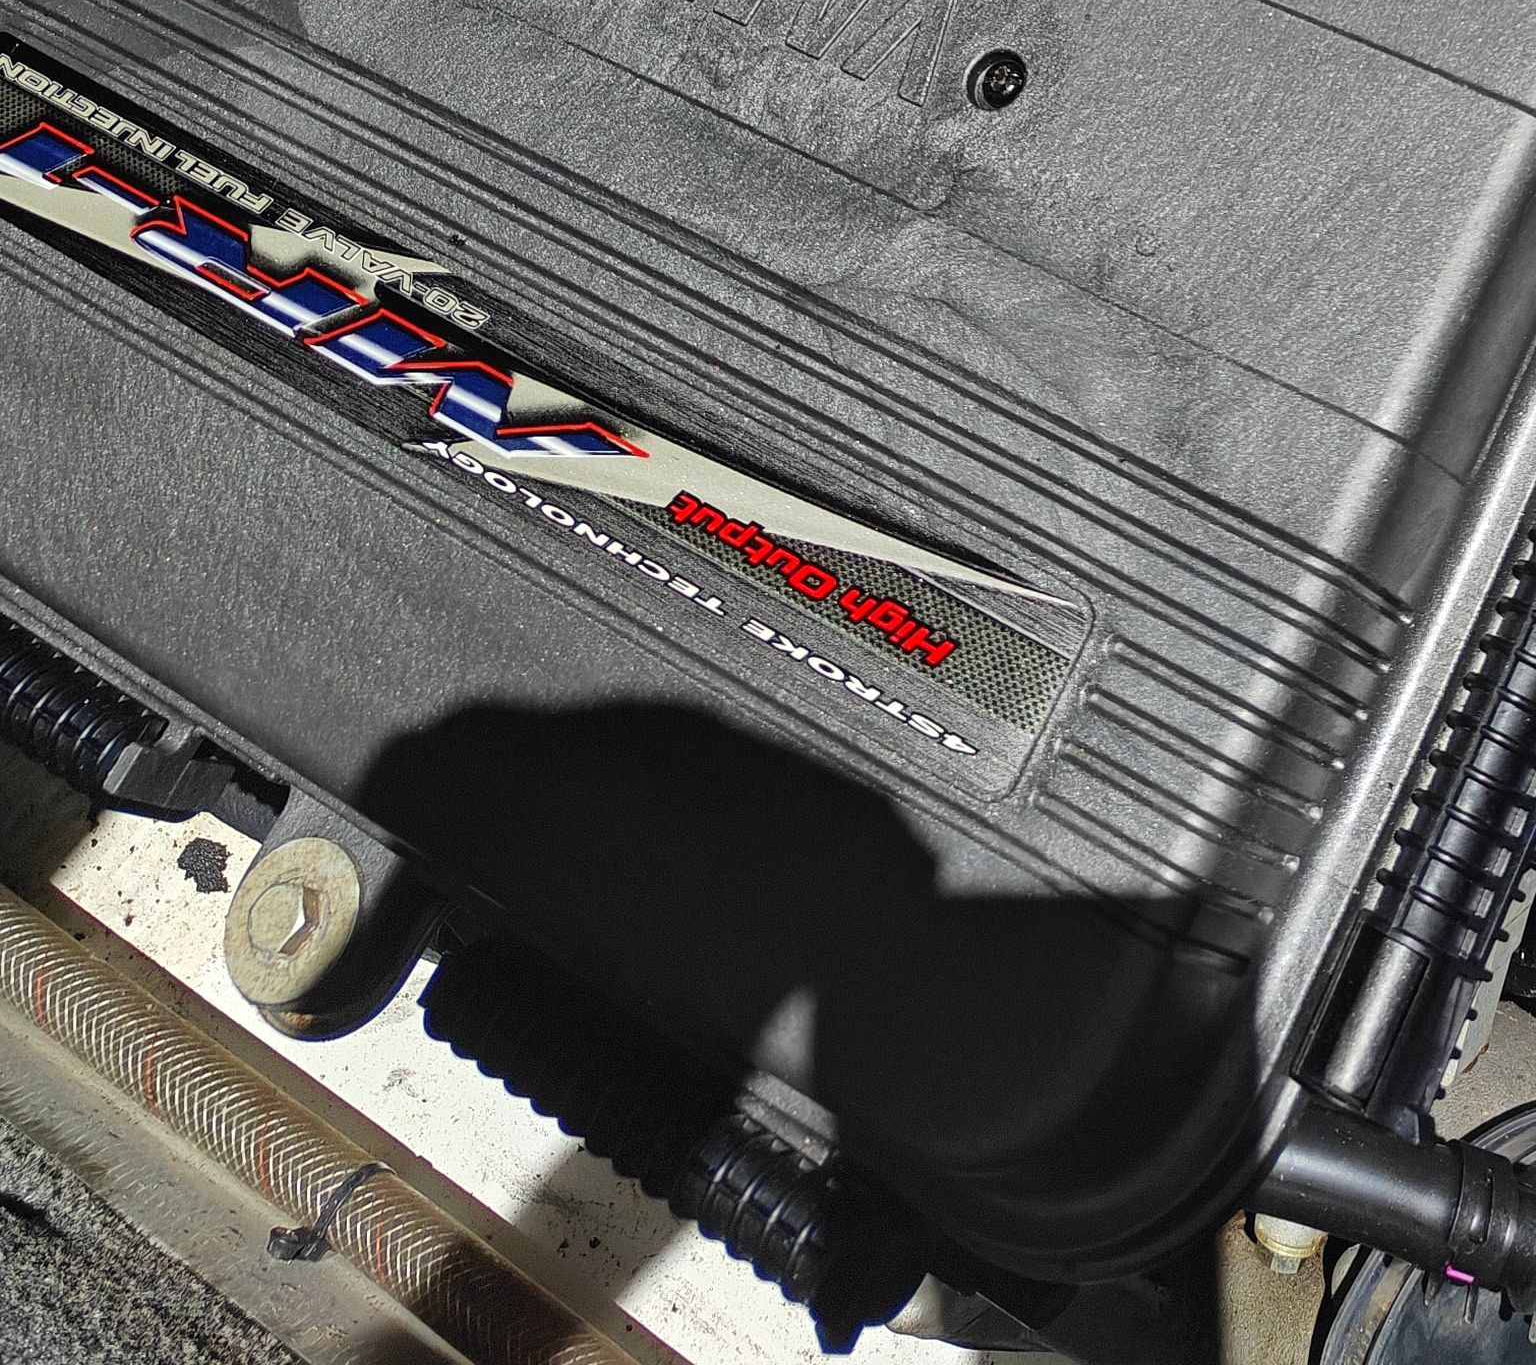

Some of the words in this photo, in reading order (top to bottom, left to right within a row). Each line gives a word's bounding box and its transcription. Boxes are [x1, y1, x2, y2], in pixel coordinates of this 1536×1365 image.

[0, 52, 178, 163] INJECTION
[174, 148, 275, 215] FUEL
[274, 206, 492, 331] 20-VALVE
[419, 439, 726, 617] TECHNOLOGY
[665, 489, 840, 603] Output
[837, 583, 960, 670] High
[740, 616, 980, 757] 4STROKE
